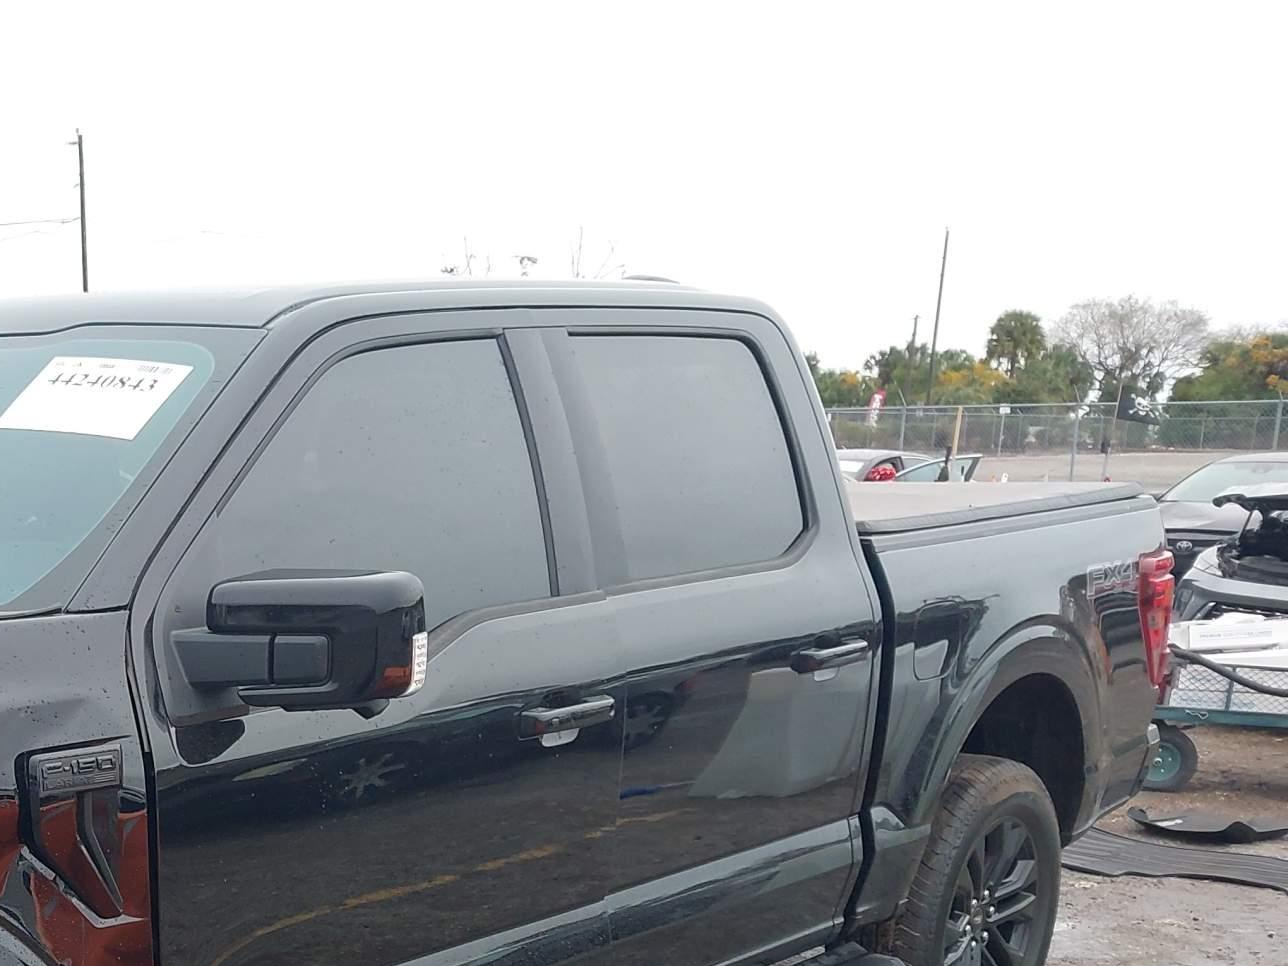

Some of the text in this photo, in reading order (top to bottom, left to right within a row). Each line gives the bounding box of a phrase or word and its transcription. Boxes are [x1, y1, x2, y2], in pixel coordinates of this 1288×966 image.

[47, 372, 159, 392] 44240843
[1086, 559, 1137, 600] FX4
[40, 754, 117, 780] F-150
